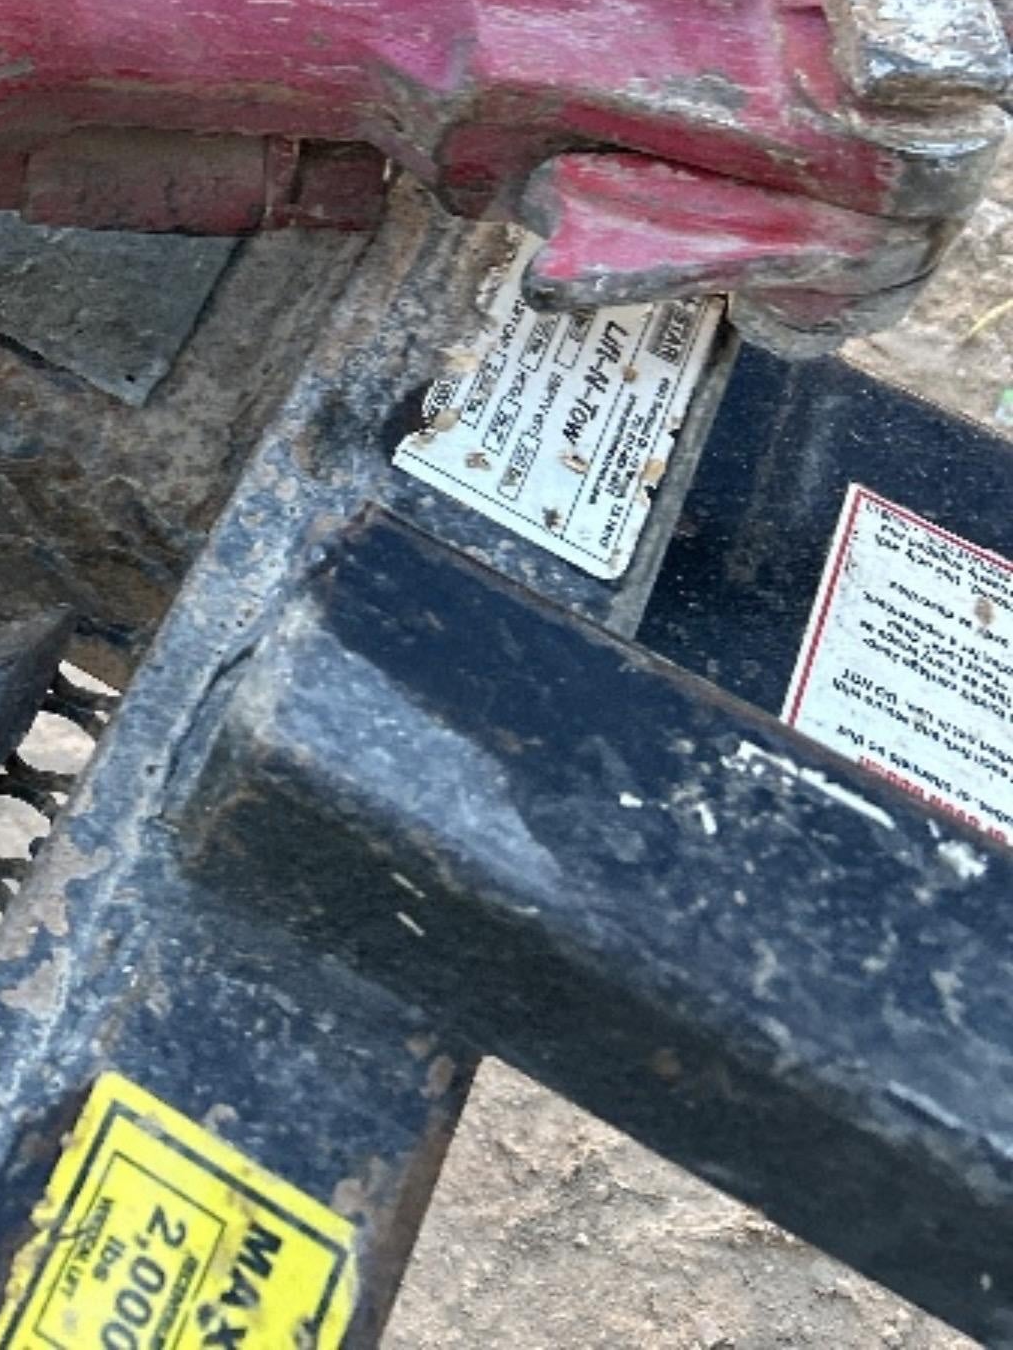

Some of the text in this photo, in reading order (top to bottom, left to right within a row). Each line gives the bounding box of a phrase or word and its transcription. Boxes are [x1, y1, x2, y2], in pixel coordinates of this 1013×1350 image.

[659, 310, 689, 365] STAR
[562, 320, 631, 448] Lift-N-Tow
[841, 668, 874, 692] NOT
[92, 1235, 127, 1283] lbs
[100, 1205, 188, 1350] 2,000
[202, 1220, 284, 1350] MAX
